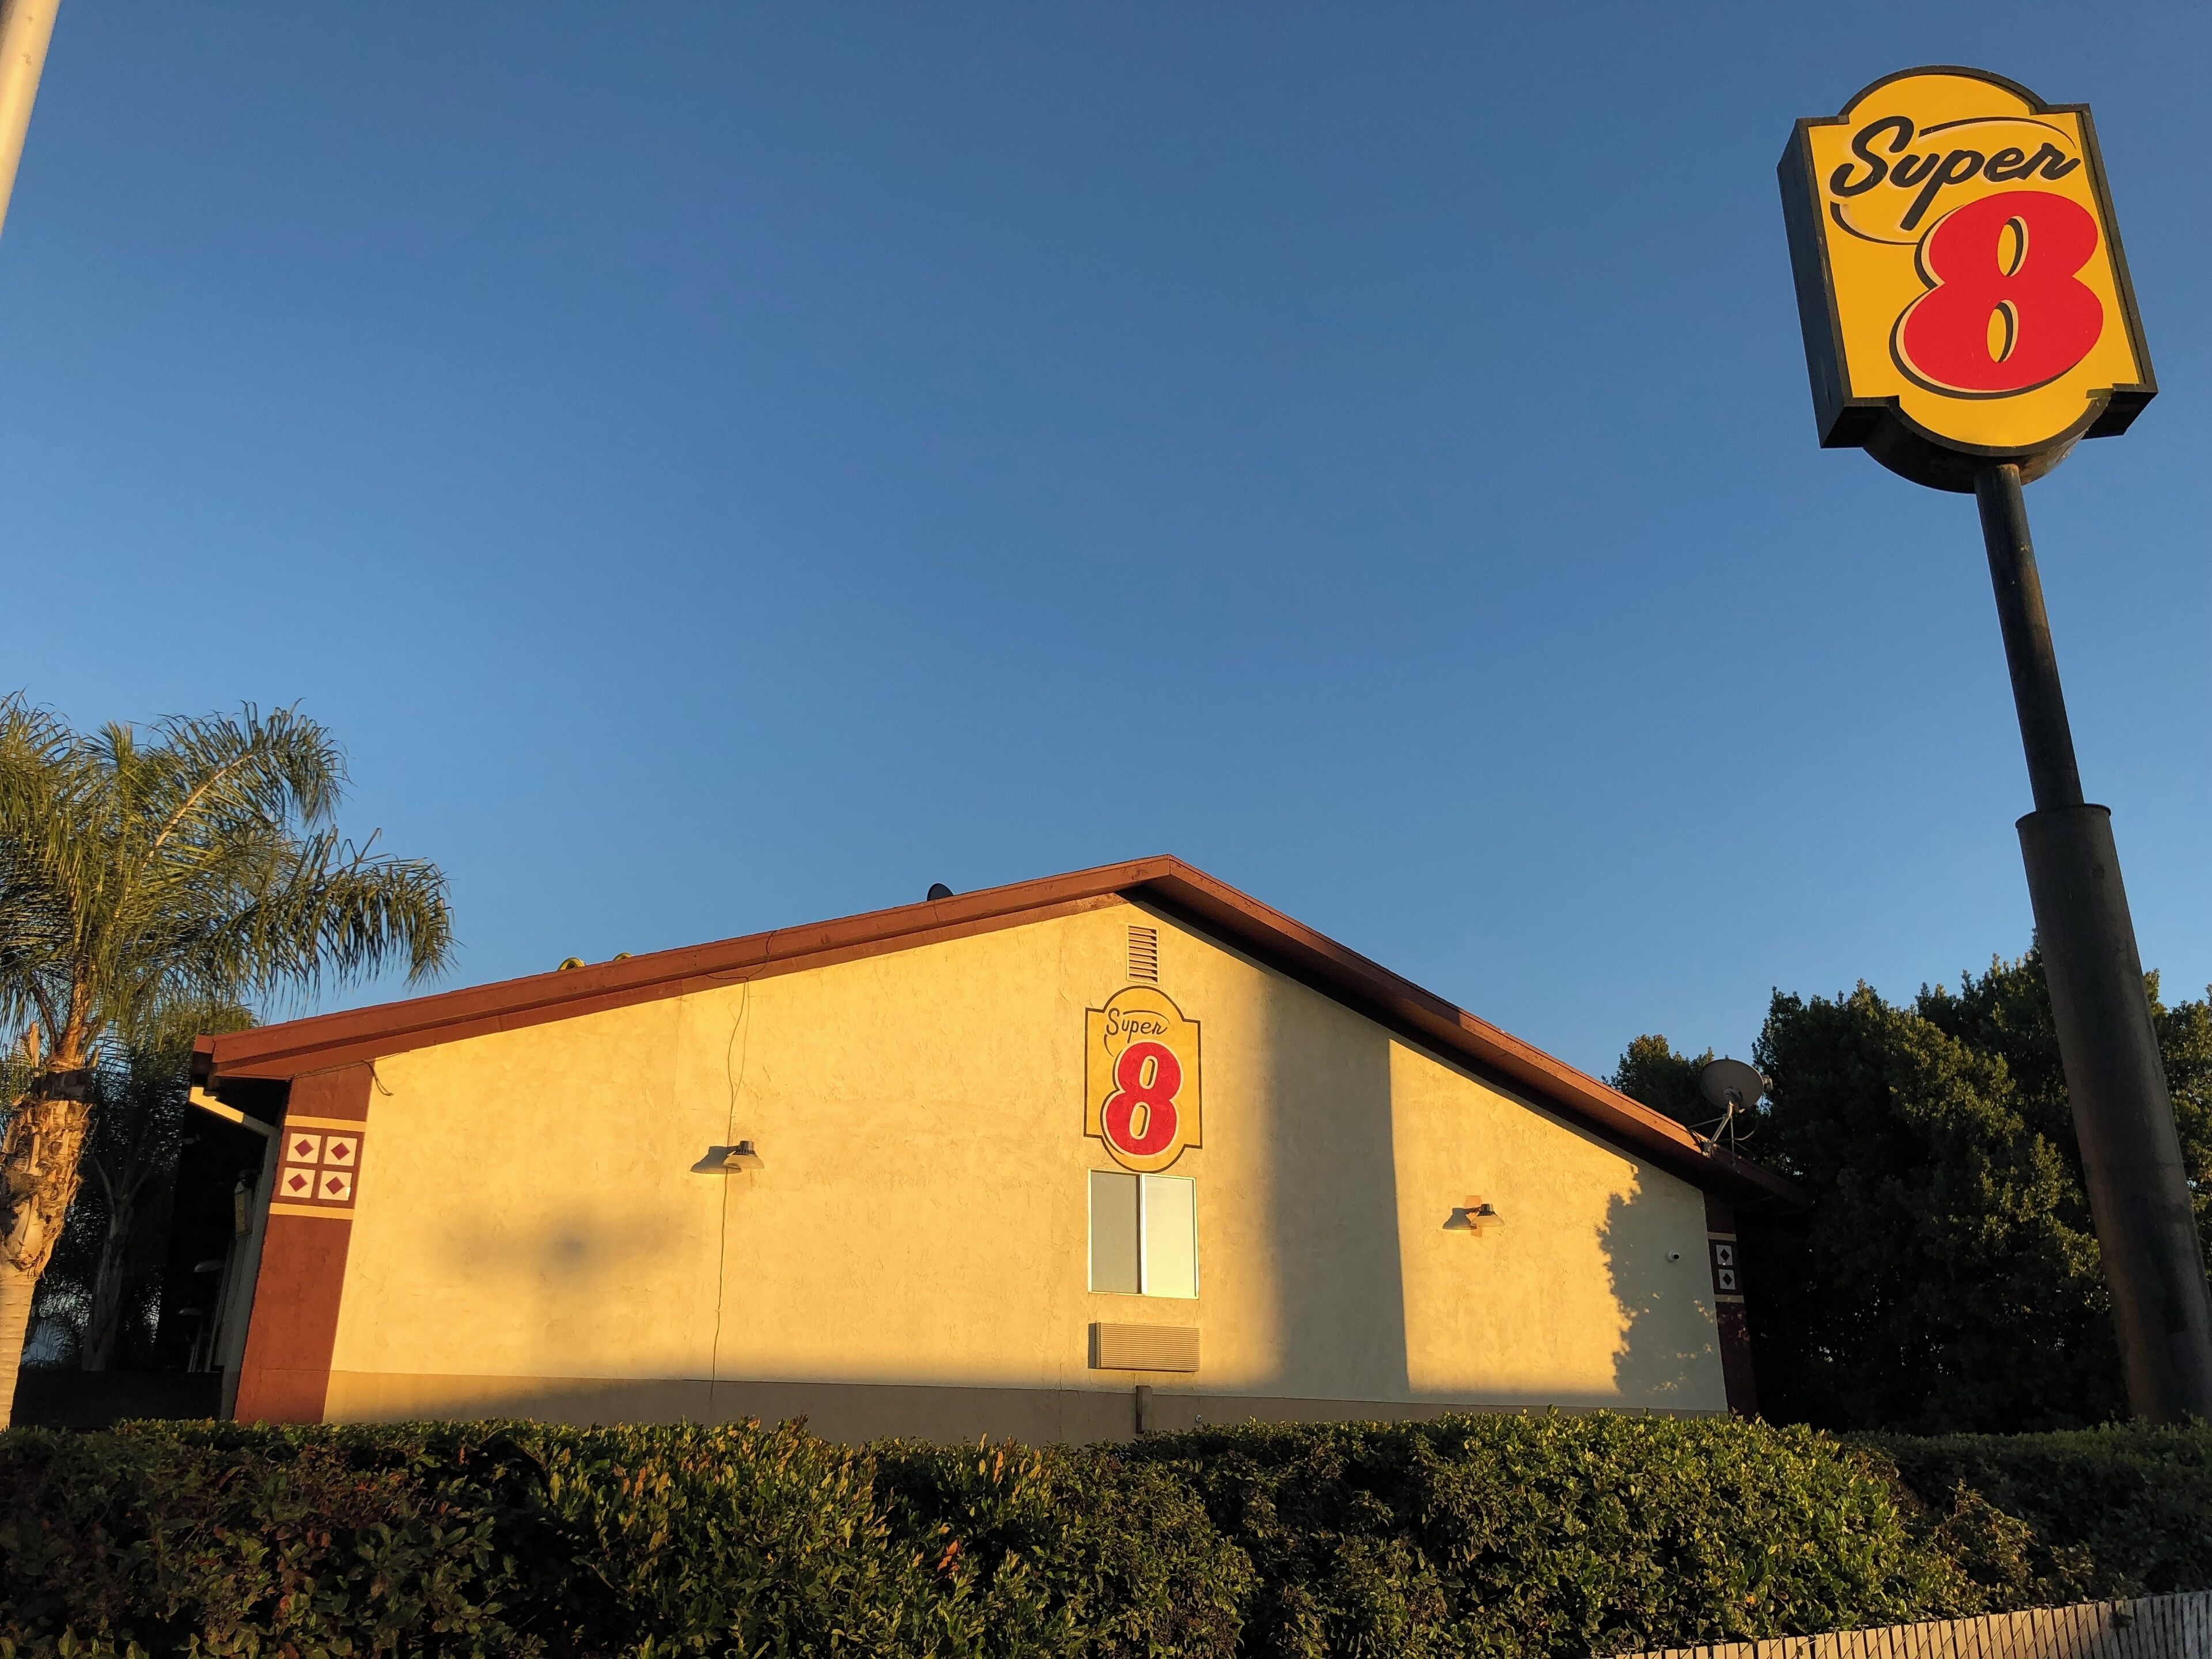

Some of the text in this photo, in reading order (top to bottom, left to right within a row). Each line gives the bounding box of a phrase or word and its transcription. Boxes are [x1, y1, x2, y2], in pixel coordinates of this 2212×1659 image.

[1830, 116, 2081, 231] Super
[1889, 191, 2104, 400] 8
[1106, 1007, 1168, 1043] Super
[1101, 1039, 1183, 1157] 8
